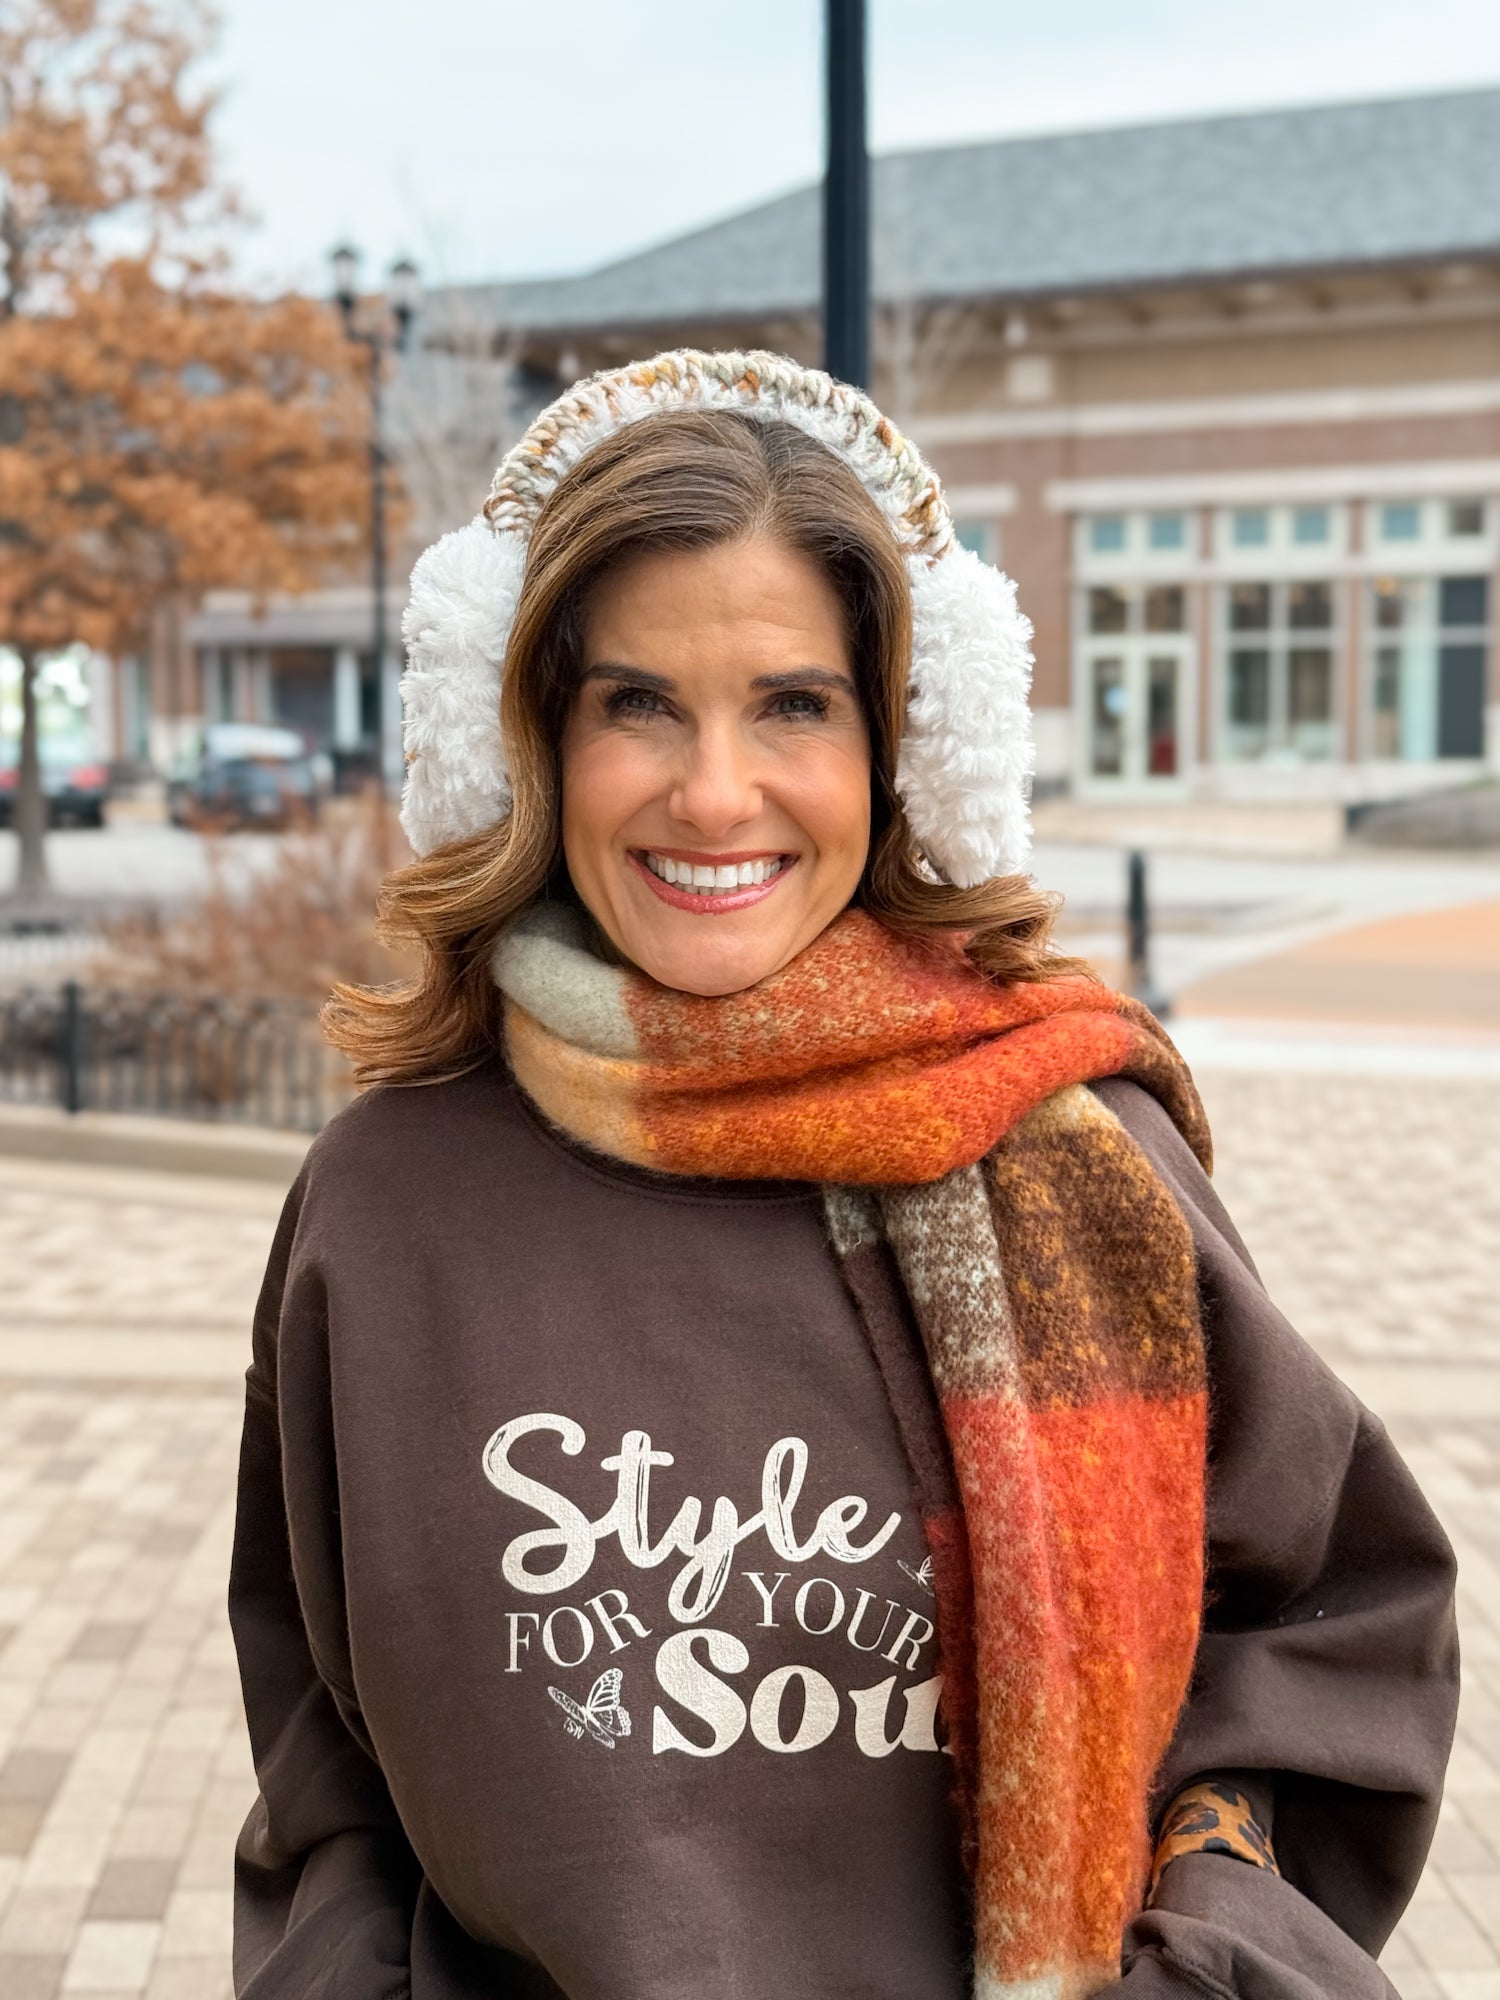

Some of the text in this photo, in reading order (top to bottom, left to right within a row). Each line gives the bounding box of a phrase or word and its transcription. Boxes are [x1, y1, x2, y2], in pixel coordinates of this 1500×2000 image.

[482, 1412, 902, 1623] Style
[504, 1571, 935, 1673] FOR YOUR
[652, 1628, 954, 1758] Sou
